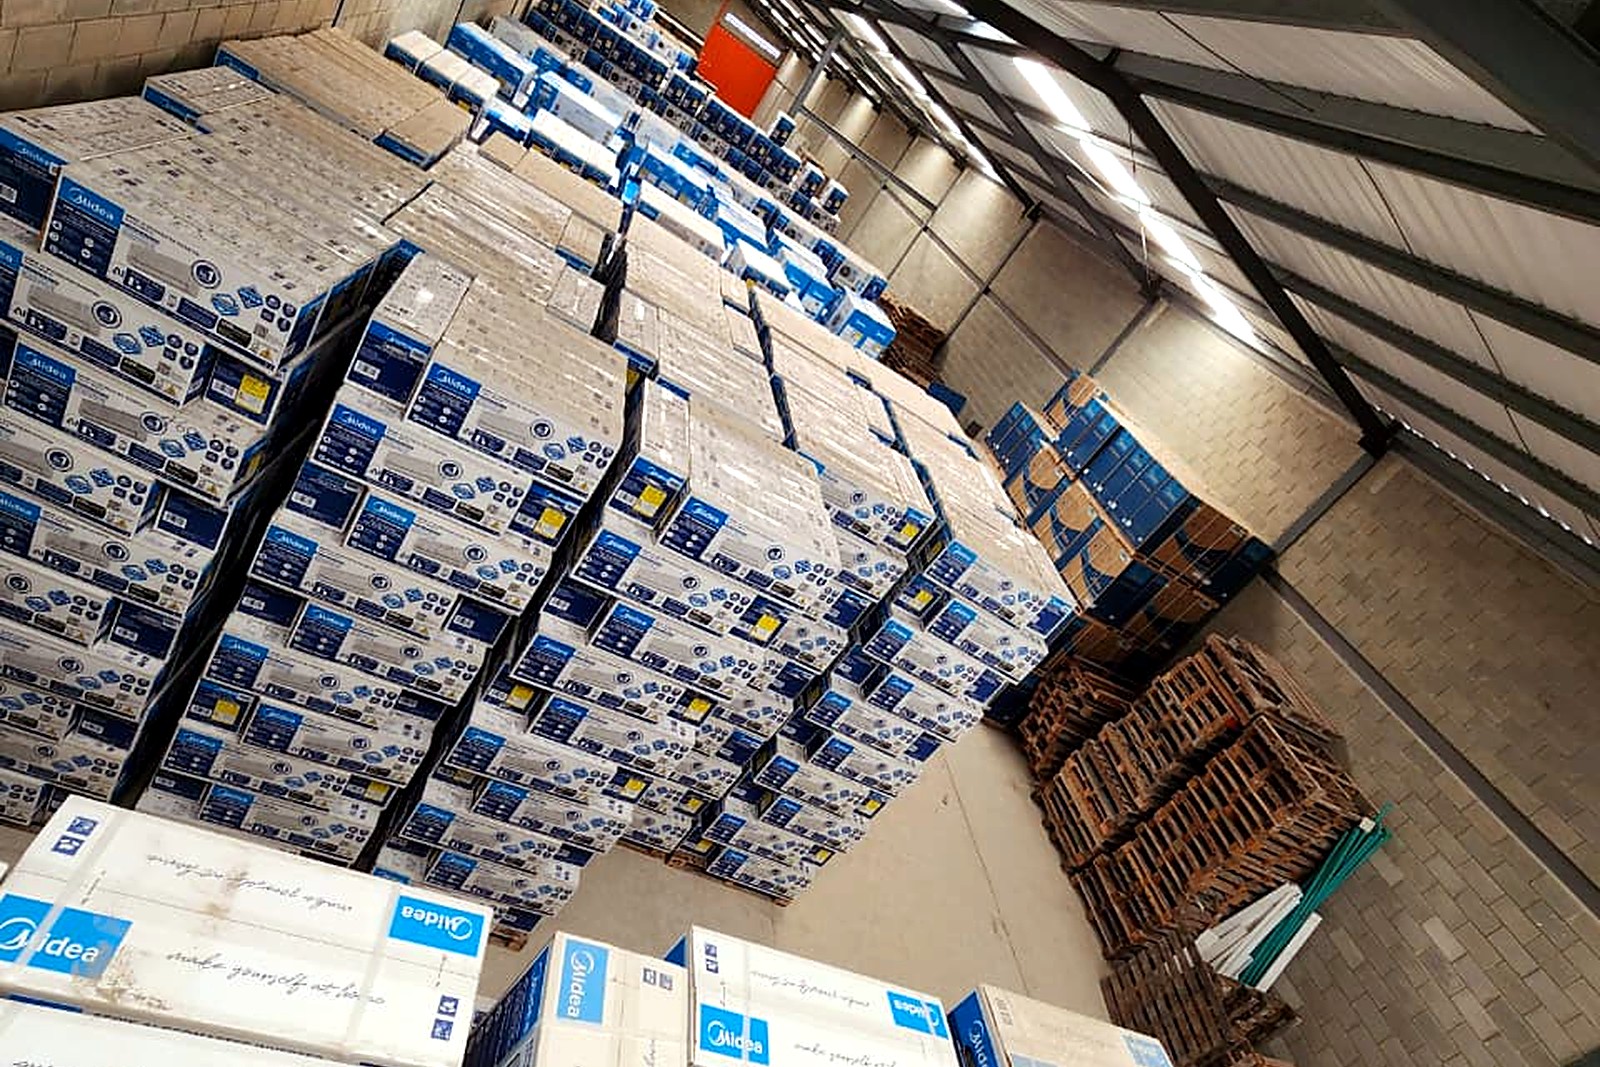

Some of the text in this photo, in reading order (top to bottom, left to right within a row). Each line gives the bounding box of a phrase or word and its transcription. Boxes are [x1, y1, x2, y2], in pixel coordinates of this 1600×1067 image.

[68, 186, 114, 221] Midea
[25, 351, 67, 380] Midea
[401, 905, 473, 940] Midea
[567, 949, 595, 1018] Midea
[707, 1020, 764, 1054] Midea
